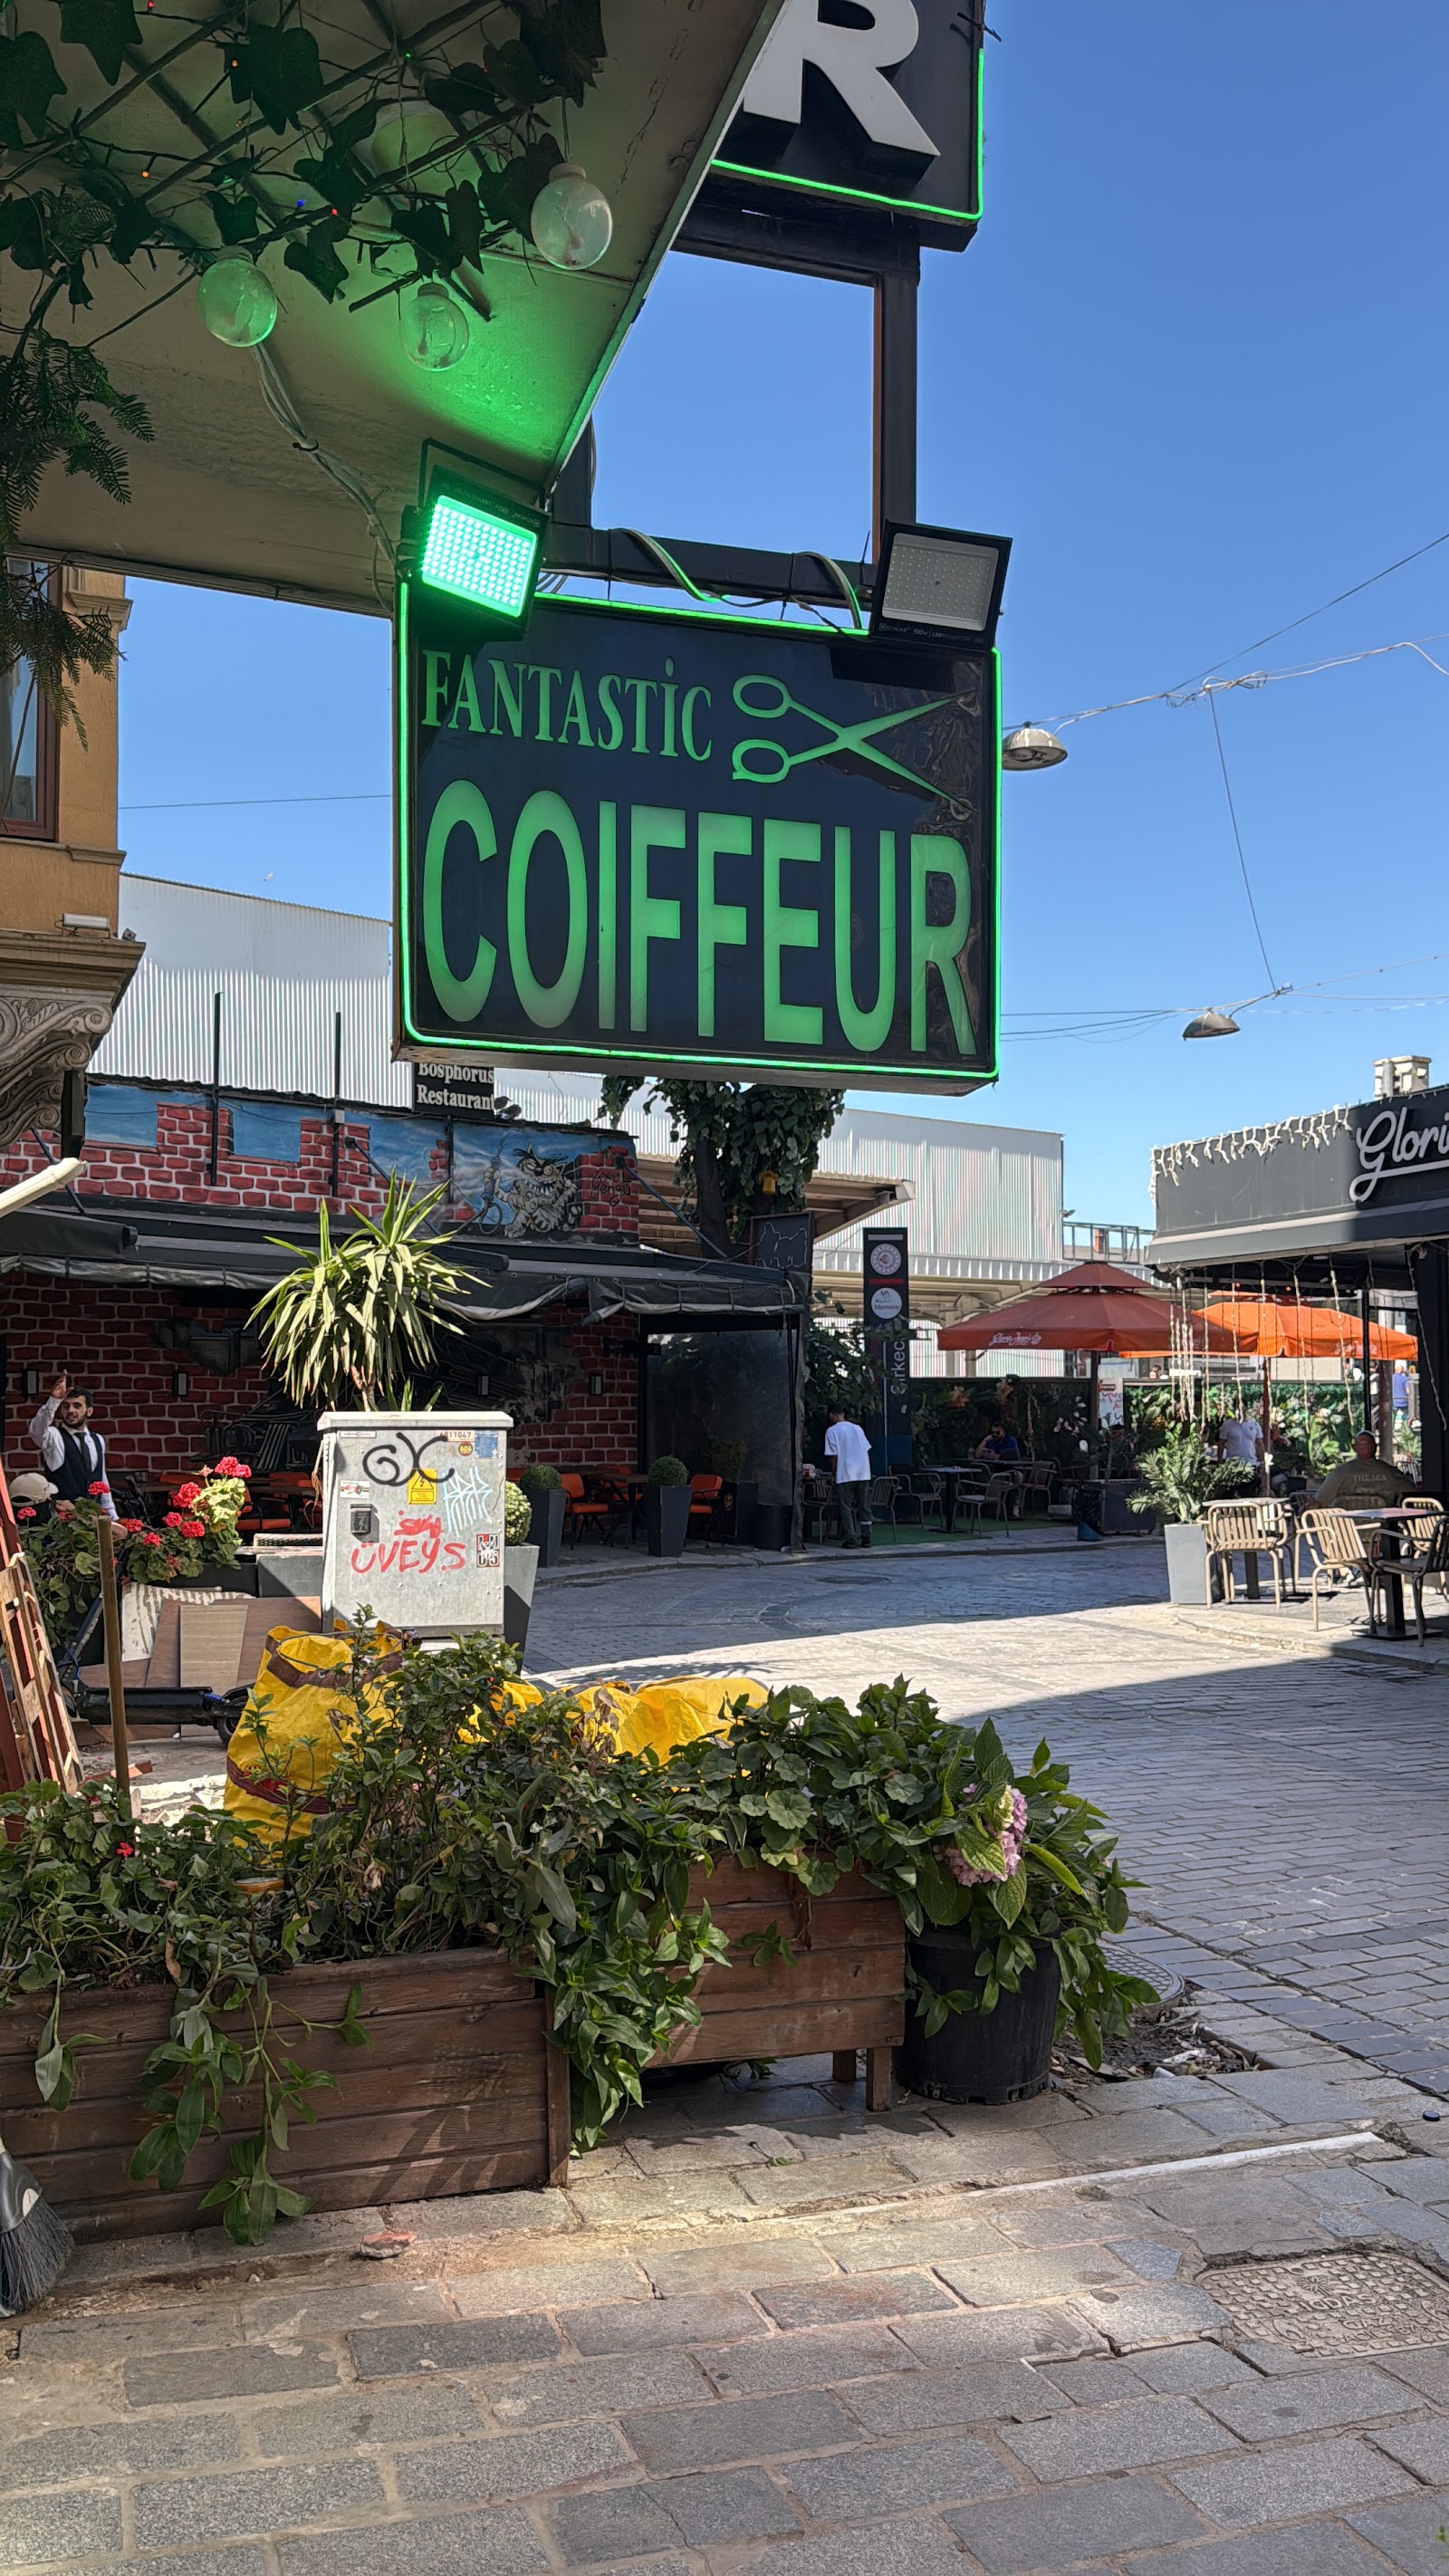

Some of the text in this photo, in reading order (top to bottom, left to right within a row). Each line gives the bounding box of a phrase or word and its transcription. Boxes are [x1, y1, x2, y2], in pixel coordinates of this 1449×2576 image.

[422, 779, 977, 1055] COIFFEUR
[417, 1063, 494, 1083] Bosphorus
[417, 1084, 495, 1110] Restaurant
[1349, 1106, 1449, 1203] Glori
[875, 1304, 900, 1312] Marmaray
[890, 1341, 906, 1395] Srkec
